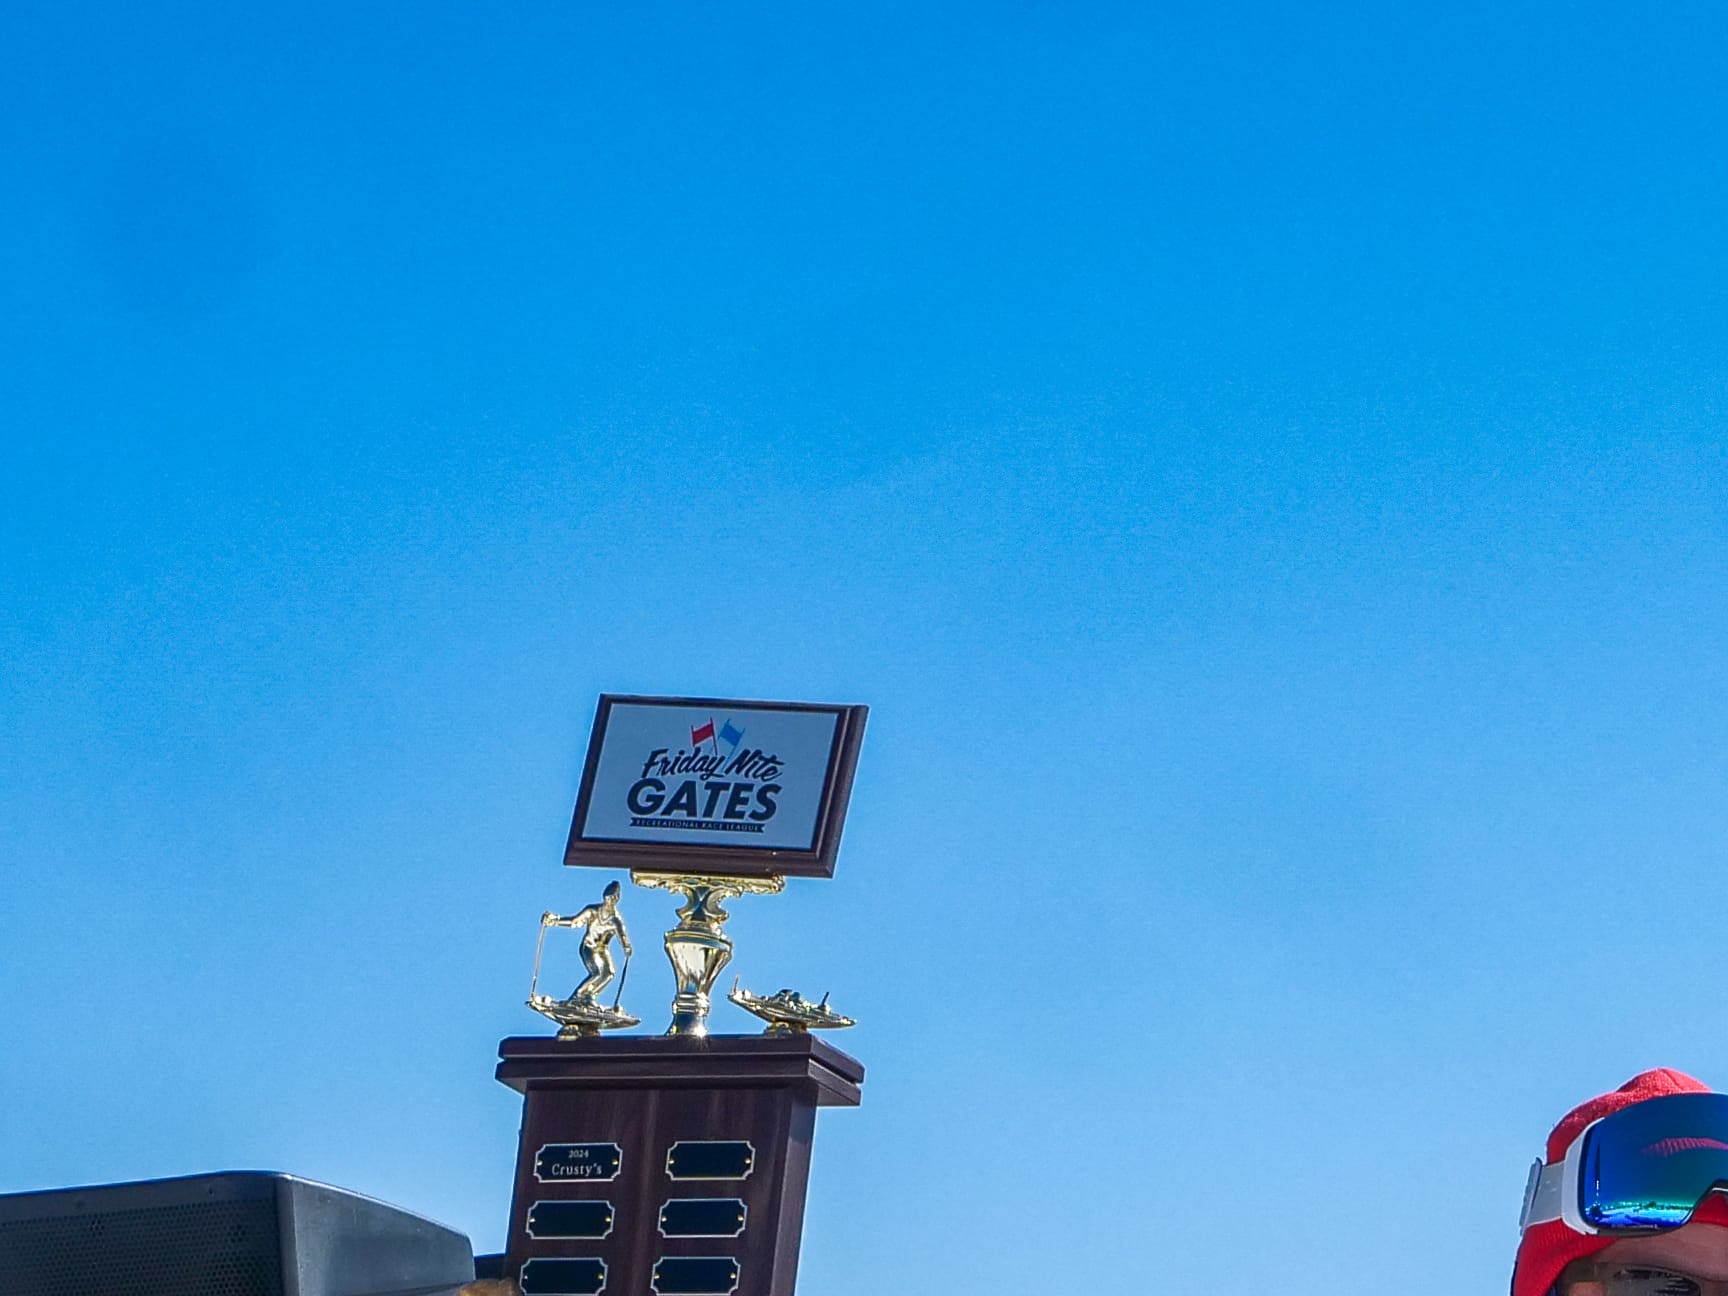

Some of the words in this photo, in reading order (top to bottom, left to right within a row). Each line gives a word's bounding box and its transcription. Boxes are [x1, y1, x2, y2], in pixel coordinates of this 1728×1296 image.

[641, 747, 726, 781] Friday
[724, 749, 786, 782] Nite
[627, 778, 782, 822] GATES
[635, 819, 699, 830] RECREATIONAL
[702, 821, 724, 830] RACE
[726, 823, 759, 832] LEAGUE
[568, 1149, 589, 1159] 2024
[551, 1163, 602, 1177] Crusty's
